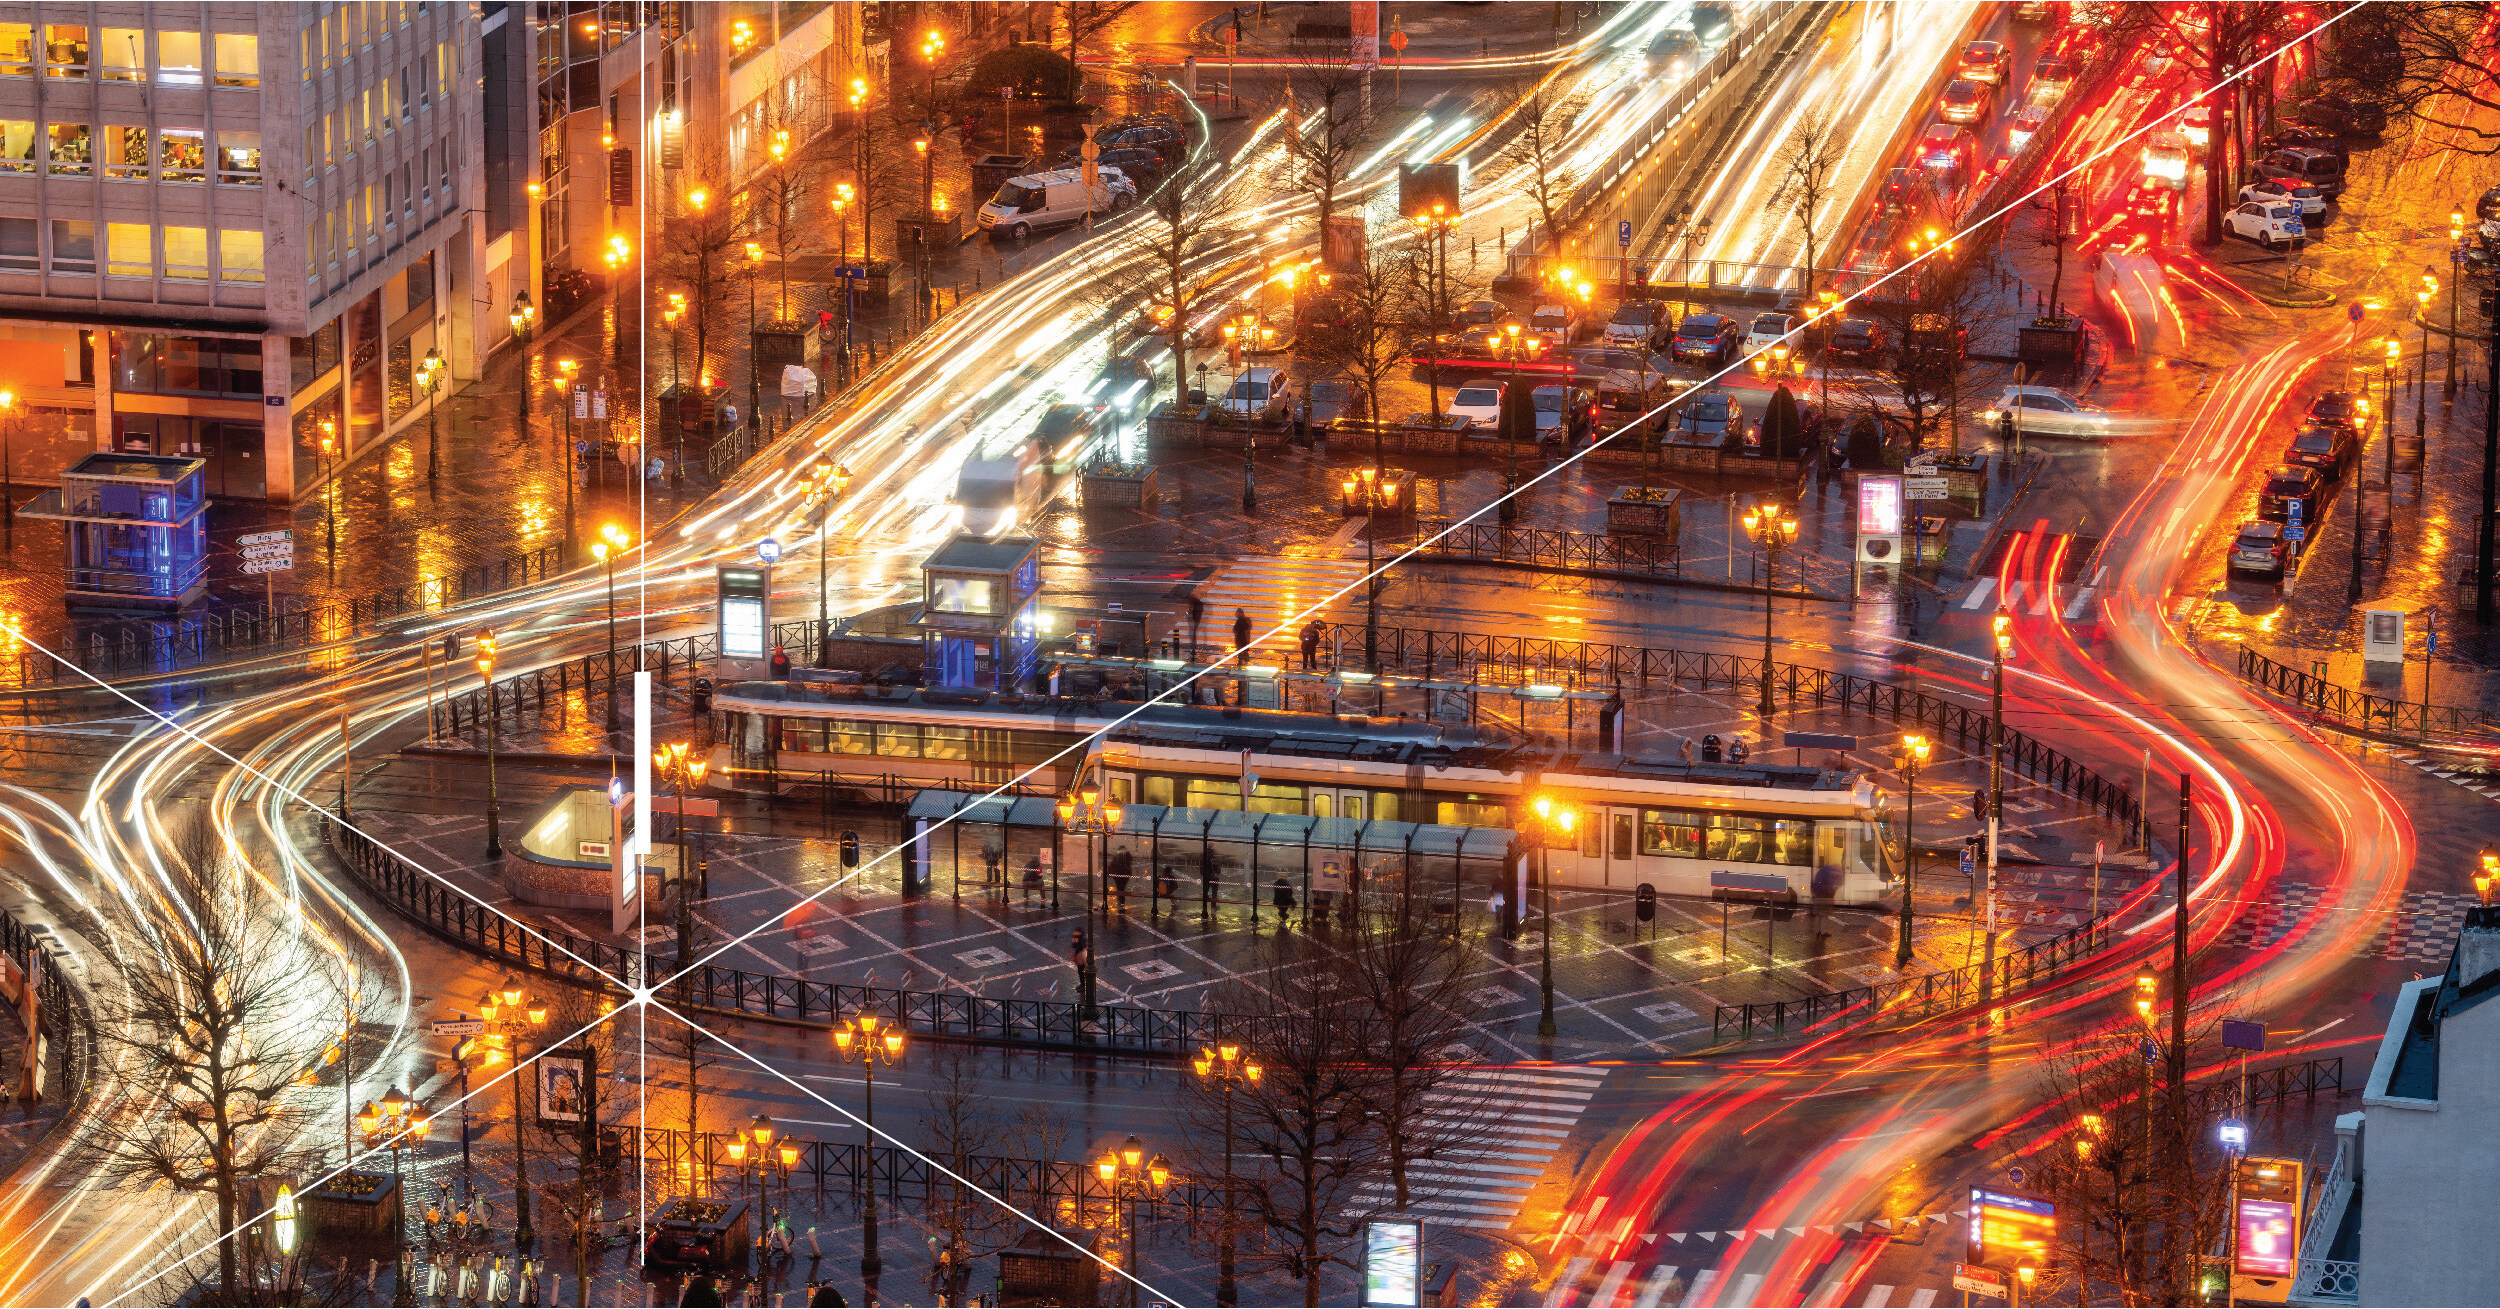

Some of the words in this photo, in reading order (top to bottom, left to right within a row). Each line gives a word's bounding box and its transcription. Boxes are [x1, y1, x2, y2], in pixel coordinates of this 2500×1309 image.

[2292, 201, 2301, 214] P
[2290, 501, 2300, 515] P
[1972, 1190, 1981, 1201] P
